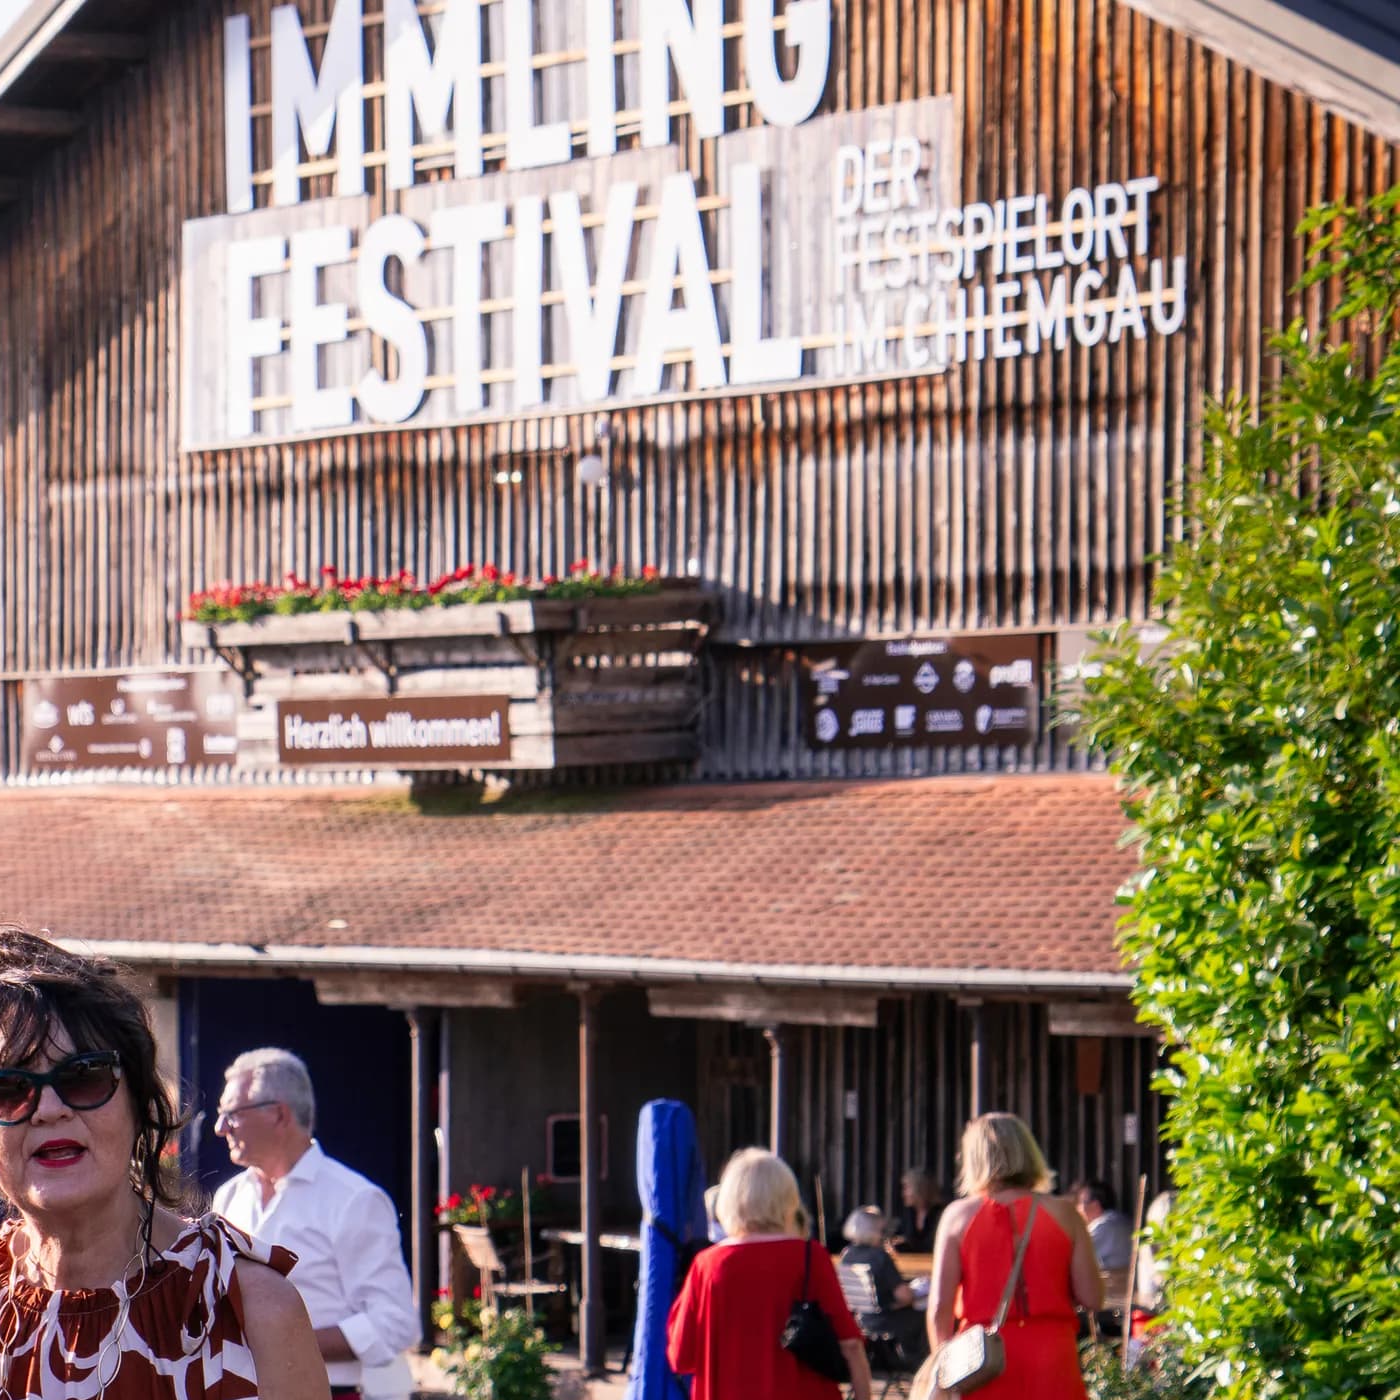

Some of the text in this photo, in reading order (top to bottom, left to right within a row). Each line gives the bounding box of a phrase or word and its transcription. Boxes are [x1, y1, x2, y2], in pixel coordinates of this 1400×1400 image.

[224, 0, 831, 214] IMMLING
[833, 136, 922, 219] DER
[834, 175, 1161, 296] FESTSPIELORT
[226, 163, 803, 438] FESTIVAL
[835, 255, 1187, 377] IM CHIEMGAU
[284, 711, 368, 750] Herzlich
[368, 709, 501, 748] willkommen!
